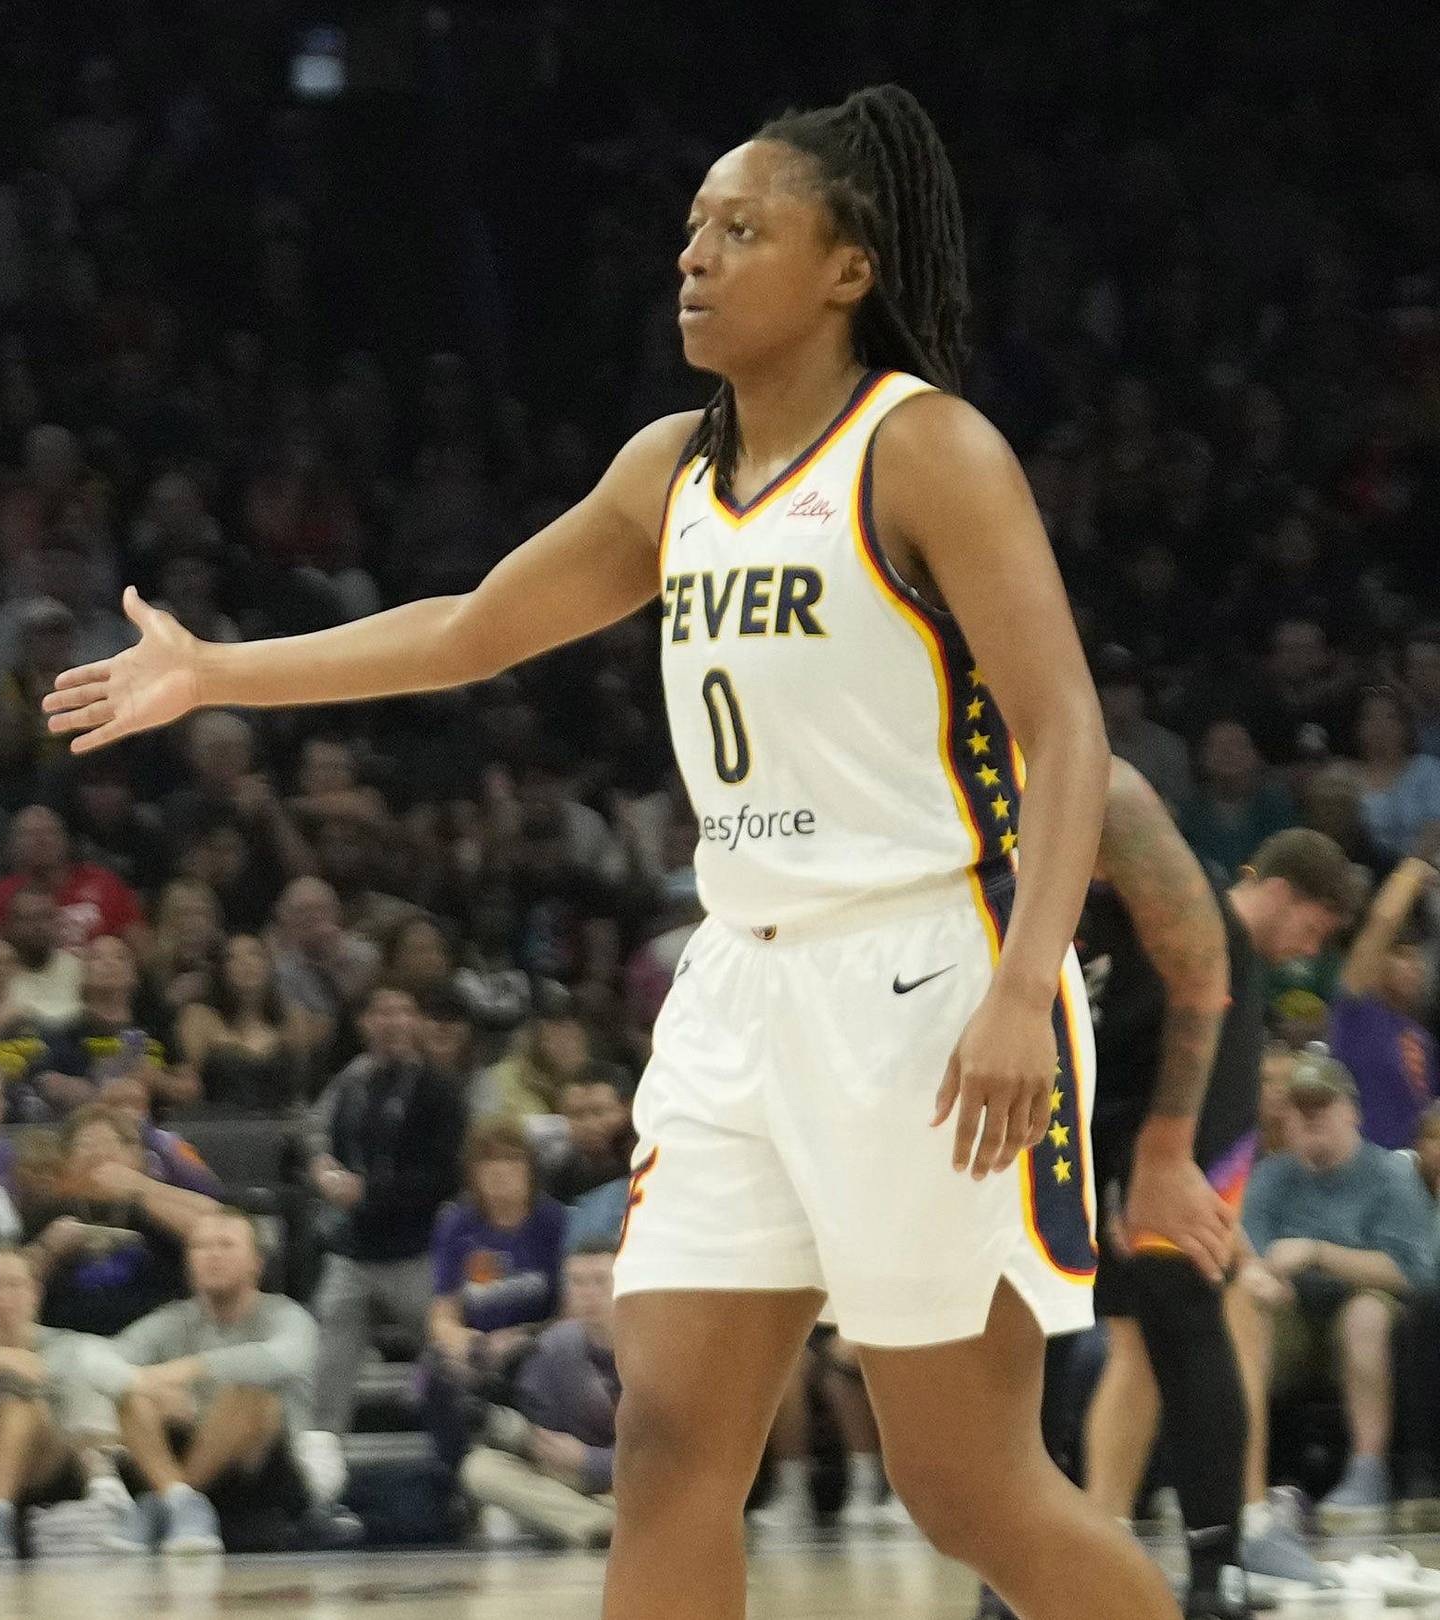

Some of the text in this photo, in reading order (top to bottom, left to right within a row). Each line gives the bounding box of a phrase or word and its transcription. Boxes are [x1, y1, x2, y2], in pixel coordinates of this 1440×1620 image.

[786, 491, 836, 525] Lilly
[702, 667, 752, 787] 0
[704, 804, 816, 851] esforce
